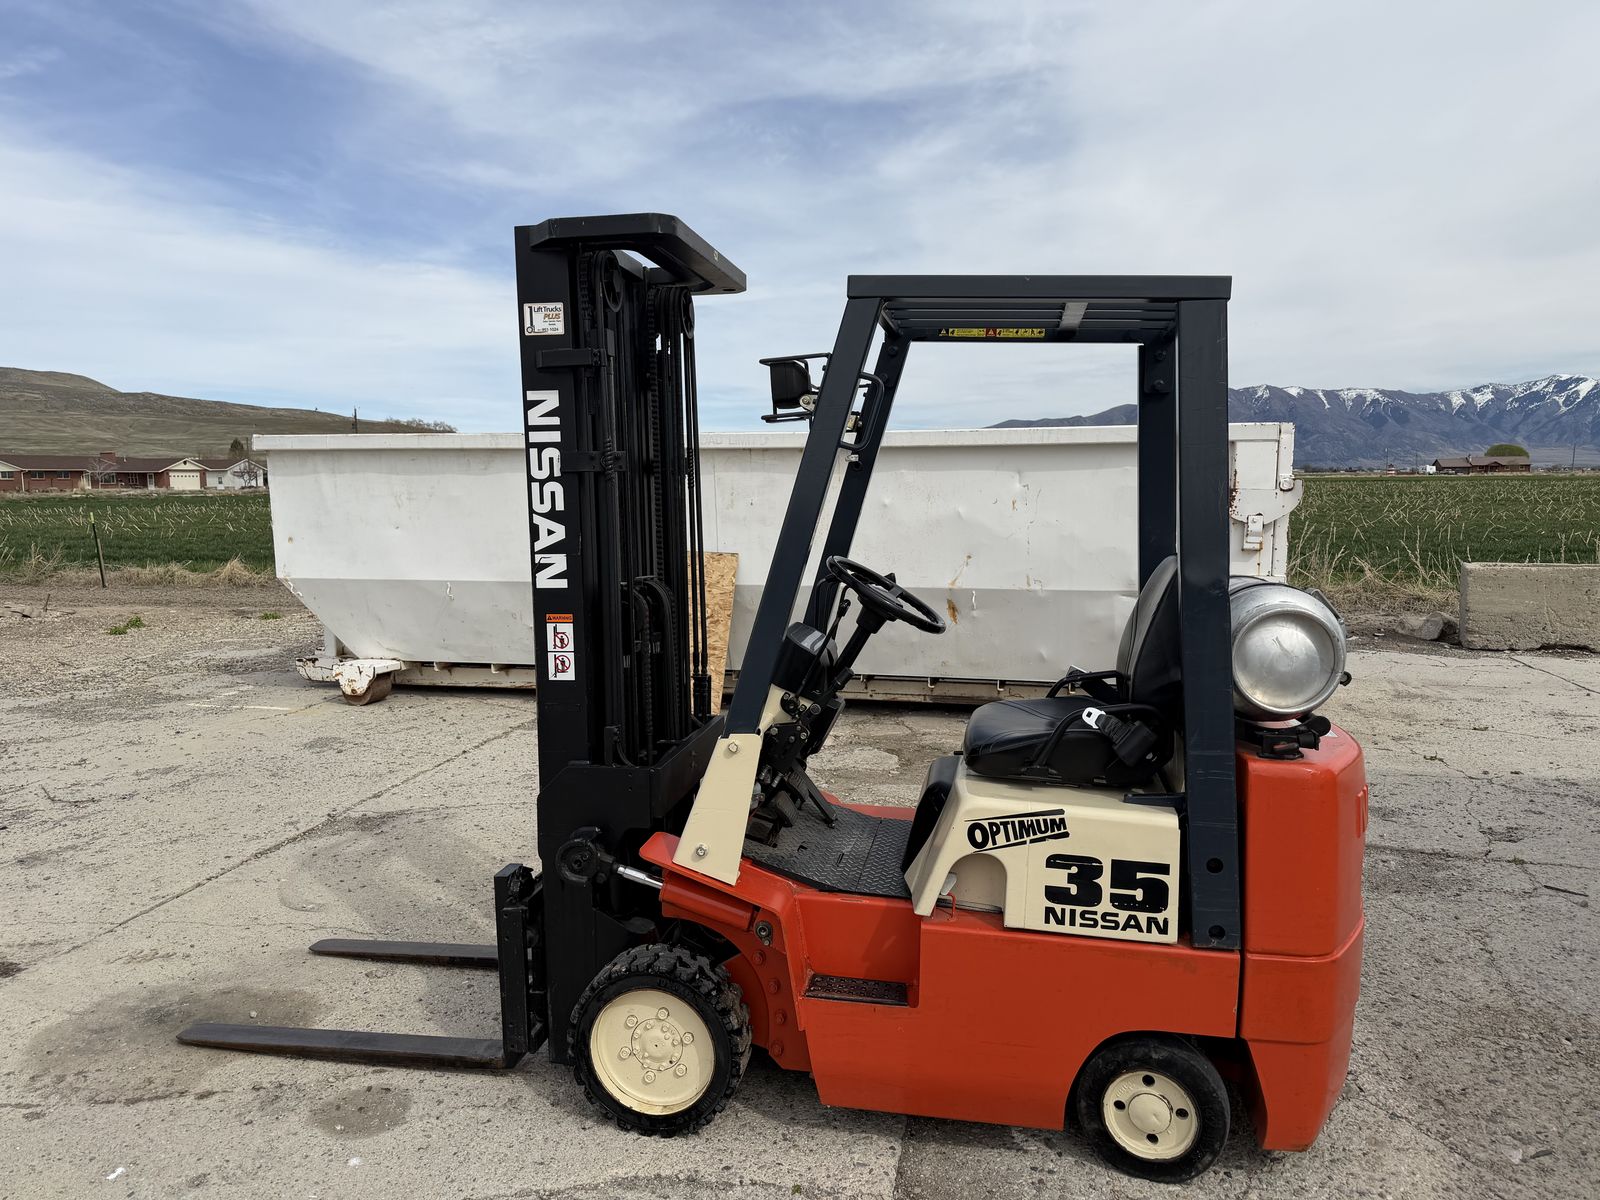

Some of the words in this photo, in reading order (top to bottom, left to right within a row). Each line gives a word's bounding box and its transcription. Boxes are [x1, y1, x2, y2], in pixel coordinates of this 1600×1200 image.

[543, 305, 562, 313] Trucks
[526, 390, 568, 588] NISSAN
[967, 817, 1068, 850] OPTIMUM
[1044, 853, 1171, 914] 35
[1044, 906, 1169, 935] NISSAN
